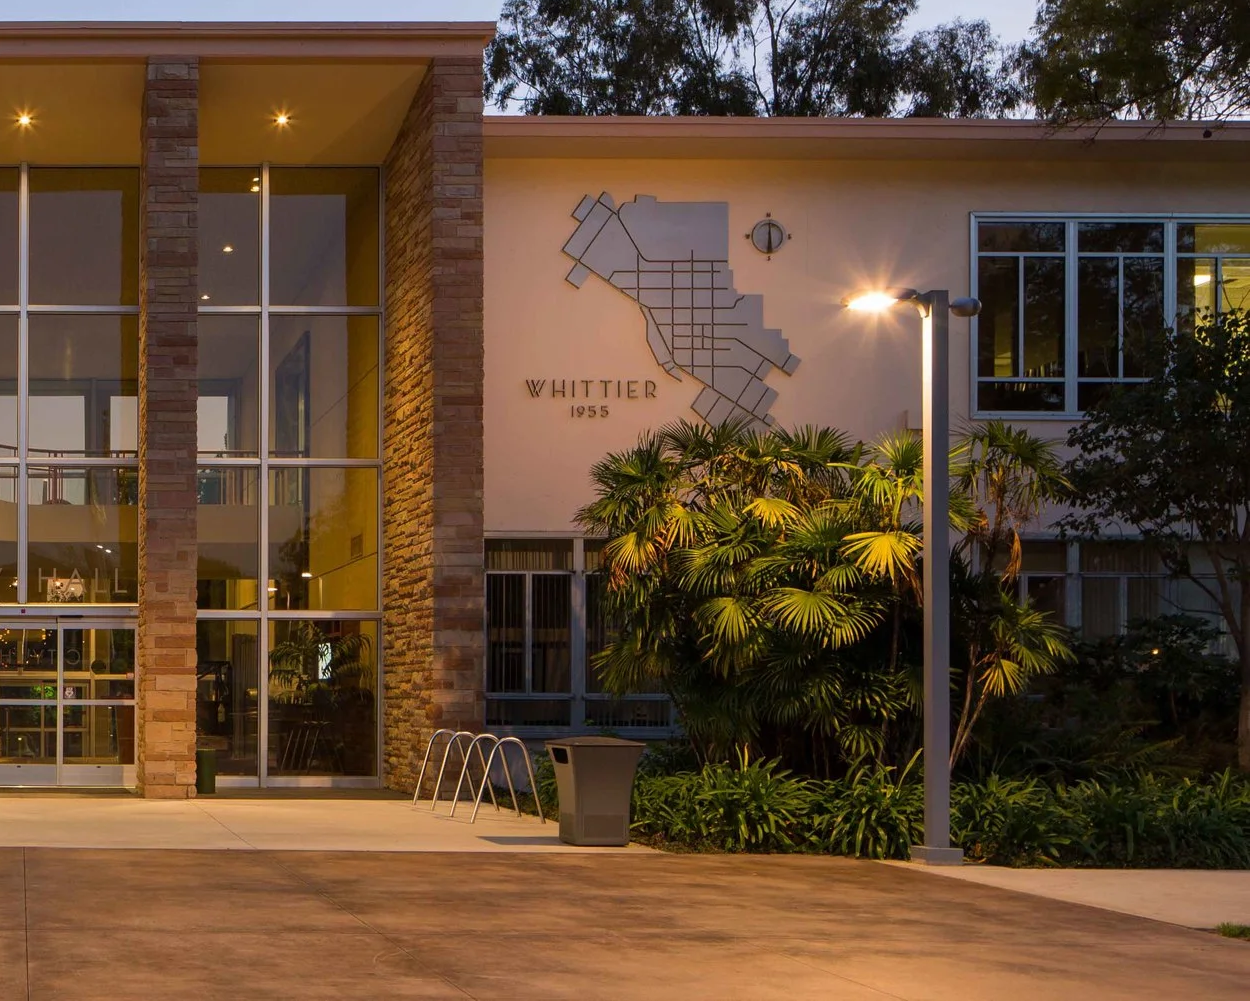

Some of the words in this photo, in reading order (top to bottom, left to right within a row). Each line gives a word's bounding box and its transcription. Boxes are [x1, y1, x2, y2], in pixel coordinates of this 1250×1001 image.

[525, 379, 657, 399] WHITTIER
[571, 405, 609, 418] 1955
[38, 567, 128, 593] HALL
